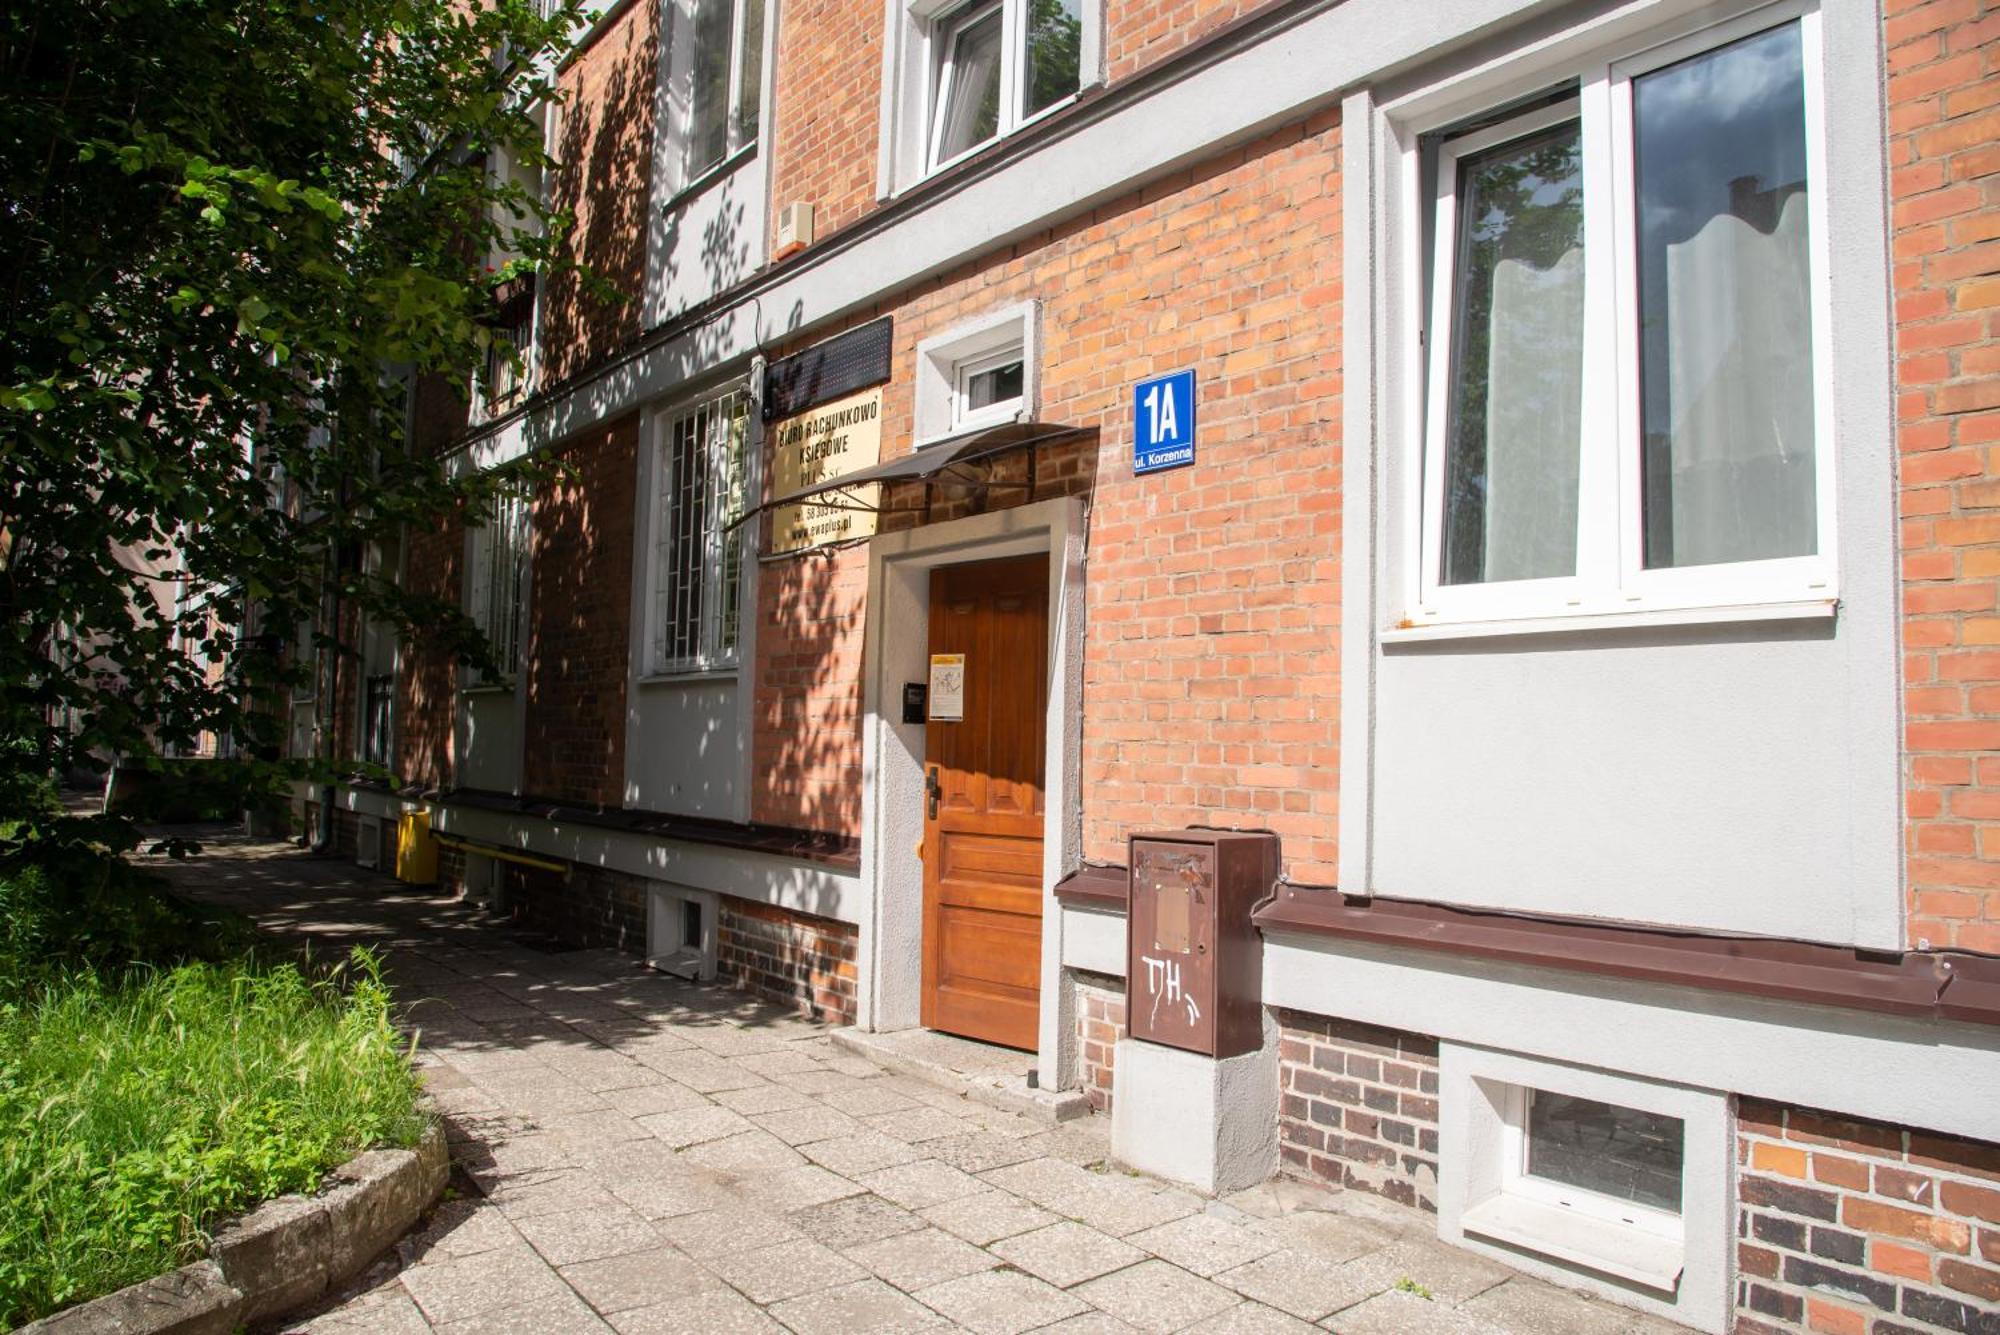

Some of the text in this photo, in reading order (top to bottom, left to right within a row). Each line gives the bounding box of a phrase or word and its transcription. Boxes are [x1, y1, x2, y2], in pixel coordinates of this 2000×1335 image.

[779, 400, 878, 447] BIURO RACHUNKOWO
[1143, 382, 1178, 444] 1A
[1135, 448, 1192, 469] ul. Korzenna
